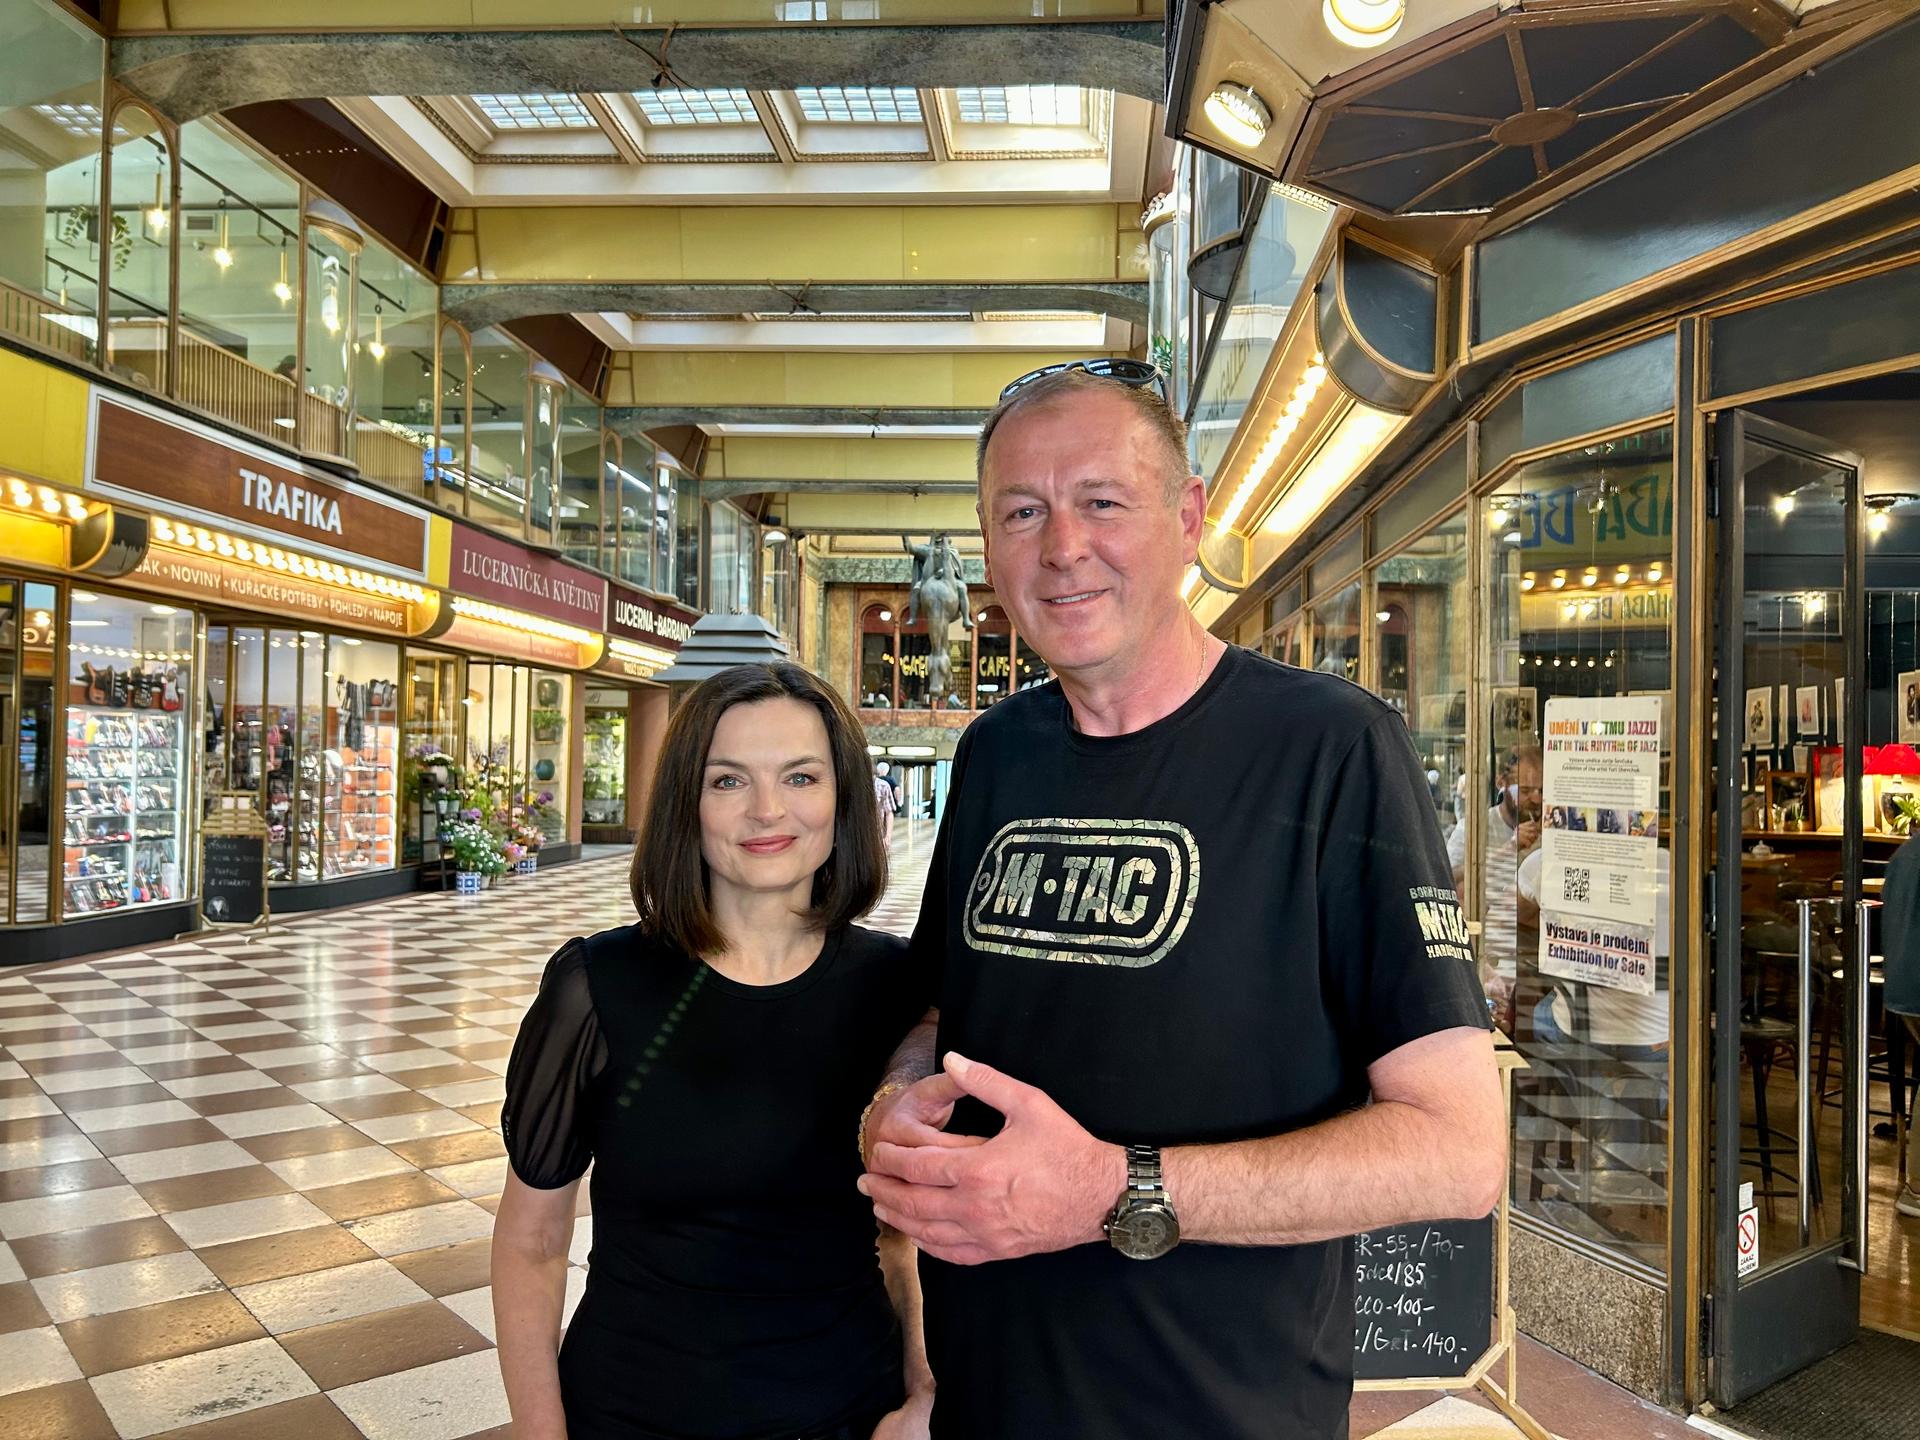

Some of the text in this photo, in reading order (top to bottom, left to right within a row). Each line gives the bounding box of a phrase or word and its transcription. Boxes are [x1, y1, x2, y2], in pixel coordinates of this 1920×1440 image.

[239, 468, 343, 535] TRAFIKA
[135, 554, 160, 576] ÁK
[170, 564, 221, 589] NOVINY
[330, 598, 368, 618] POHLEDY
[1582, 721, 1589, 735] V
[1627, 720, 1657, 736] JAZZU
[1547, 740, 1658, 752] ART IN THE RHYTHM OF JAZZ
[1546, 921, 1650, 955] Výstava je prodejní
[1548, 943, 1602, 968] Exhibition
[1604, 953, 1619, 970] for
[1620, 956, 1646, 976] Sale
